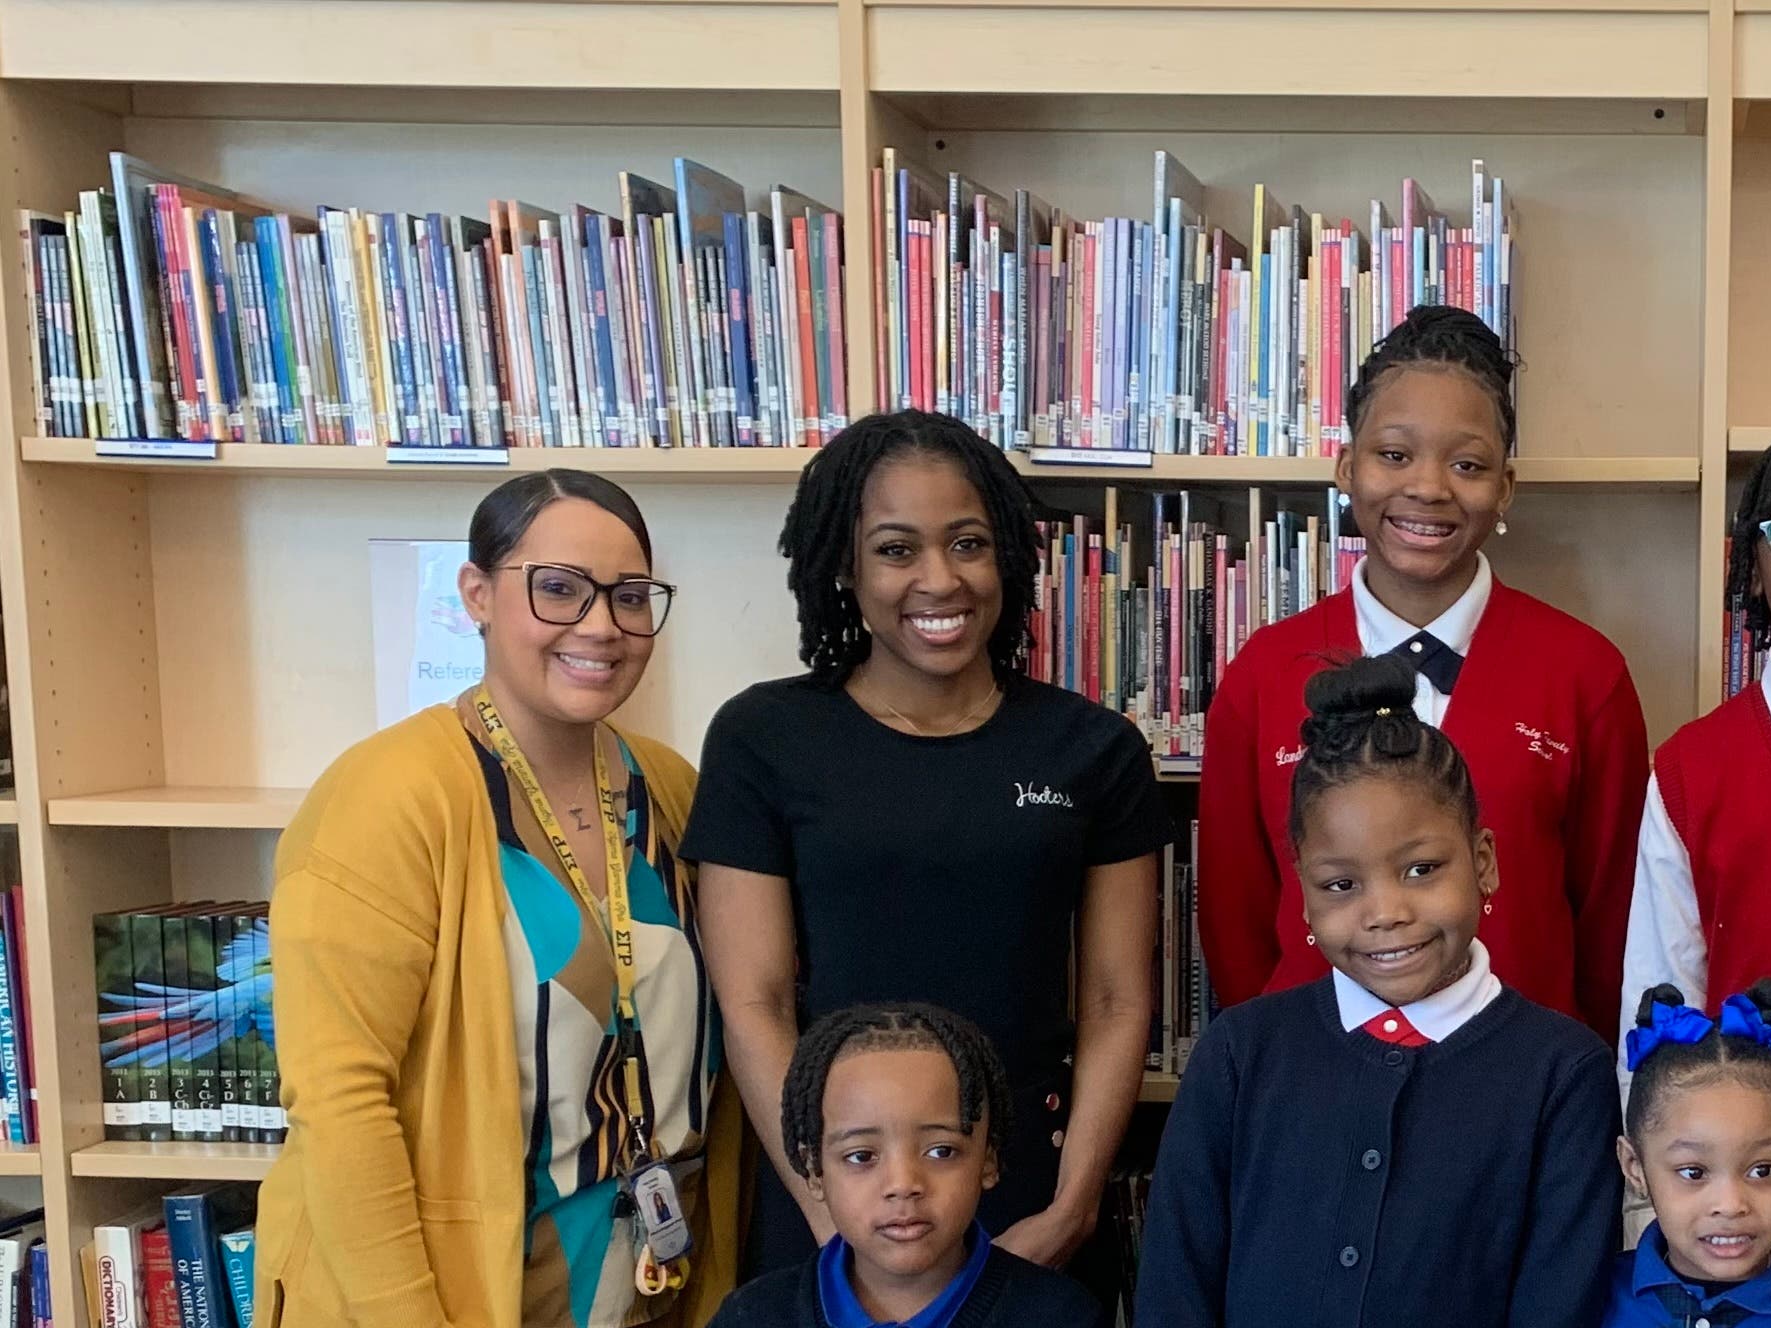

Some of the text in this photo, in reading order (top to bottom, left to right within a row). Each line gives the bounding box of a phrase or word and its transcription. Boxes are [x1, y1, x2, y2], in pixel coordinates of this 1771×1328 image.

[1014, 782, 1075, 809] Hooters
[117, 1078, 122, 1088] 1
[148, 1078, 157, 1088] 2
[177, 1078, 184, 1088] 3
[202, 1078, 210, 1088] 4
[225, 1079, 232, 1088] 5
[244, 1079, 252, 1088] 6
[265, 1079, 272, 1088] 7
[177, 1259, 189, 1276] OF
[191, 1258, 204, 1283] THE
